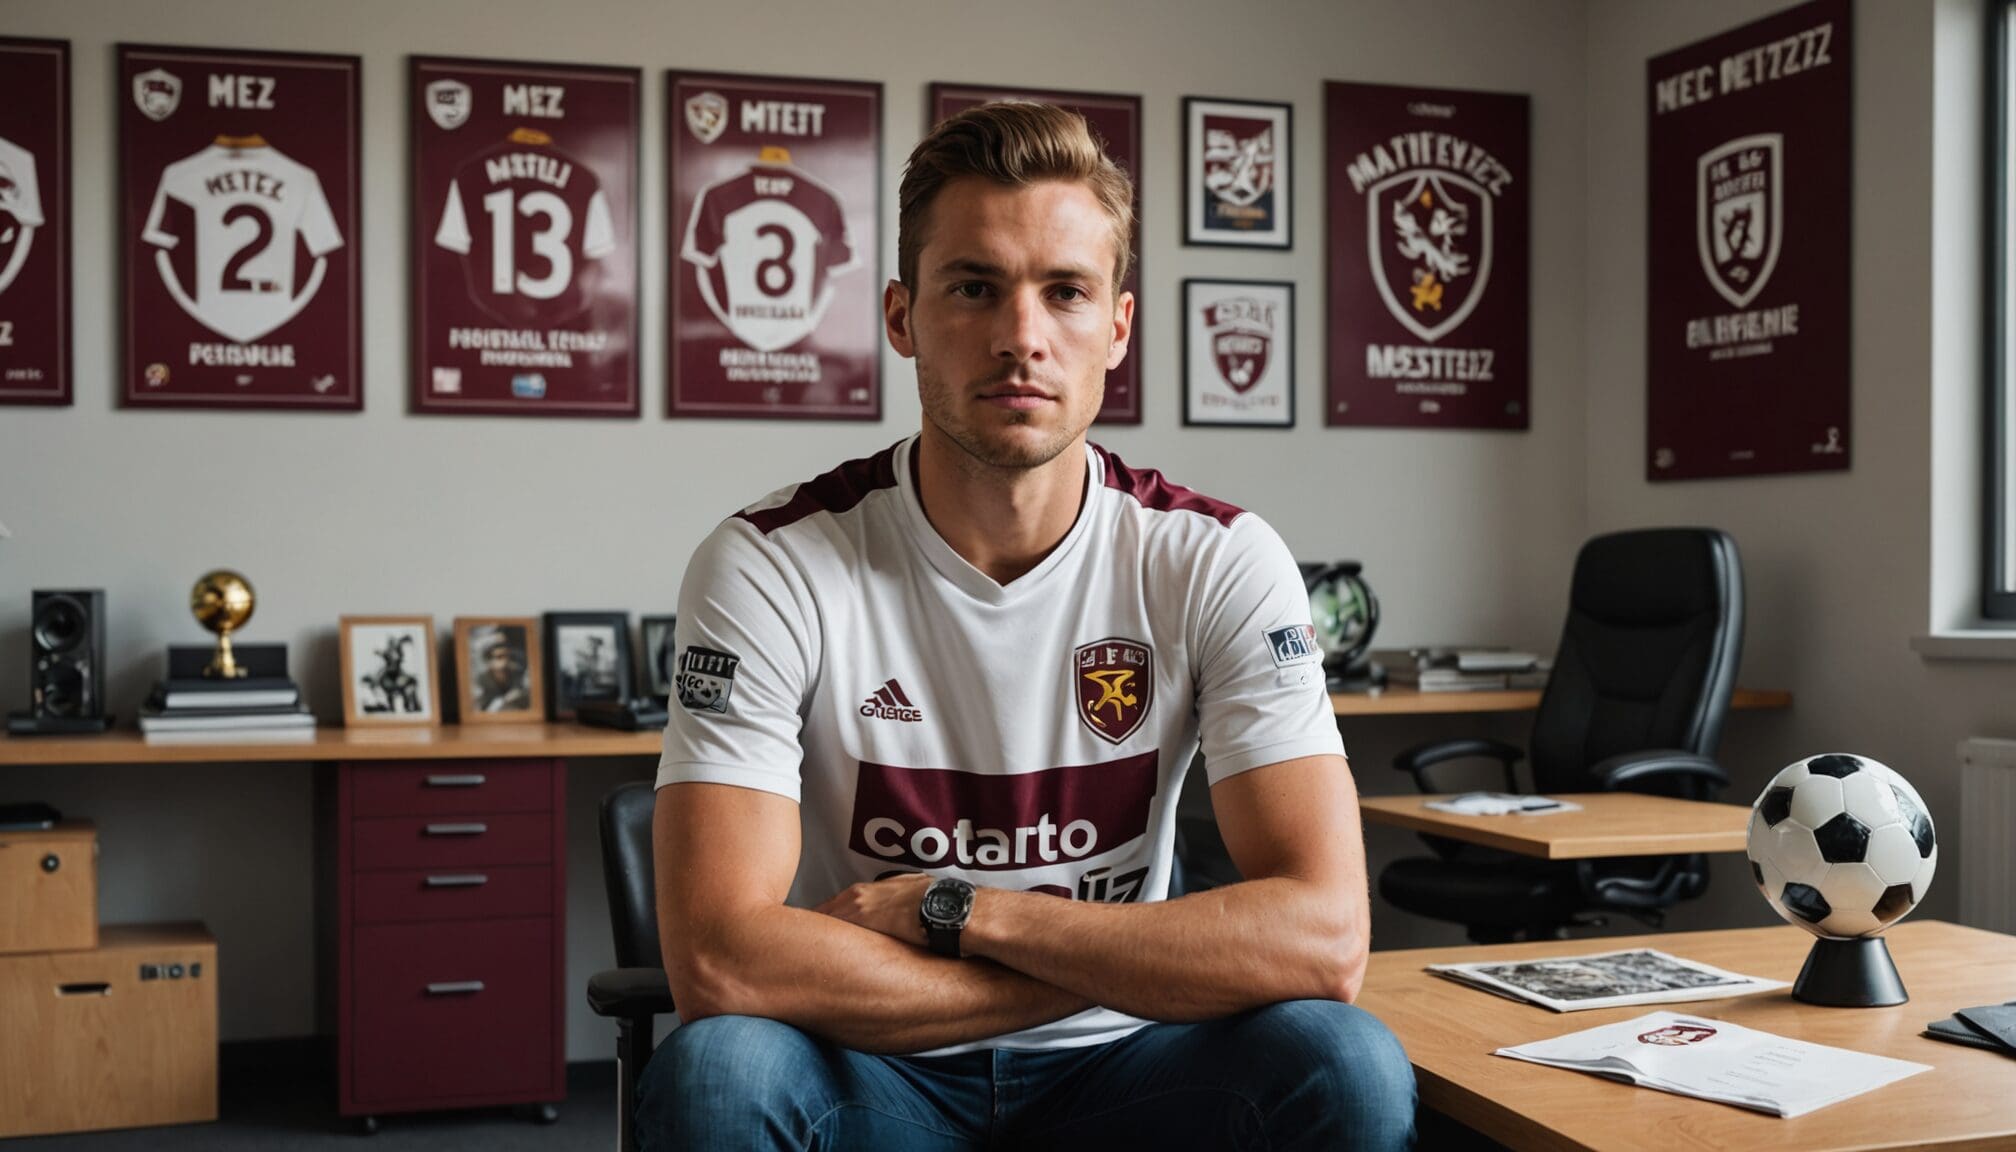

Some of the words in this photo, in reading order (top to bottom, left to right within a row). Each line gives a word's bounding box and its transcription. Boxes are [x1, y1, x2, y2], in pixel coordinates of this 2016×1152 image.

[208, 74, 276, 109] MEZ
[503, 84, 565, 118] MEZ
[221, 202, 274, 292] 2
[484, 188, 573, 299] 13
[863, 813, 1098, 866] cotarto
